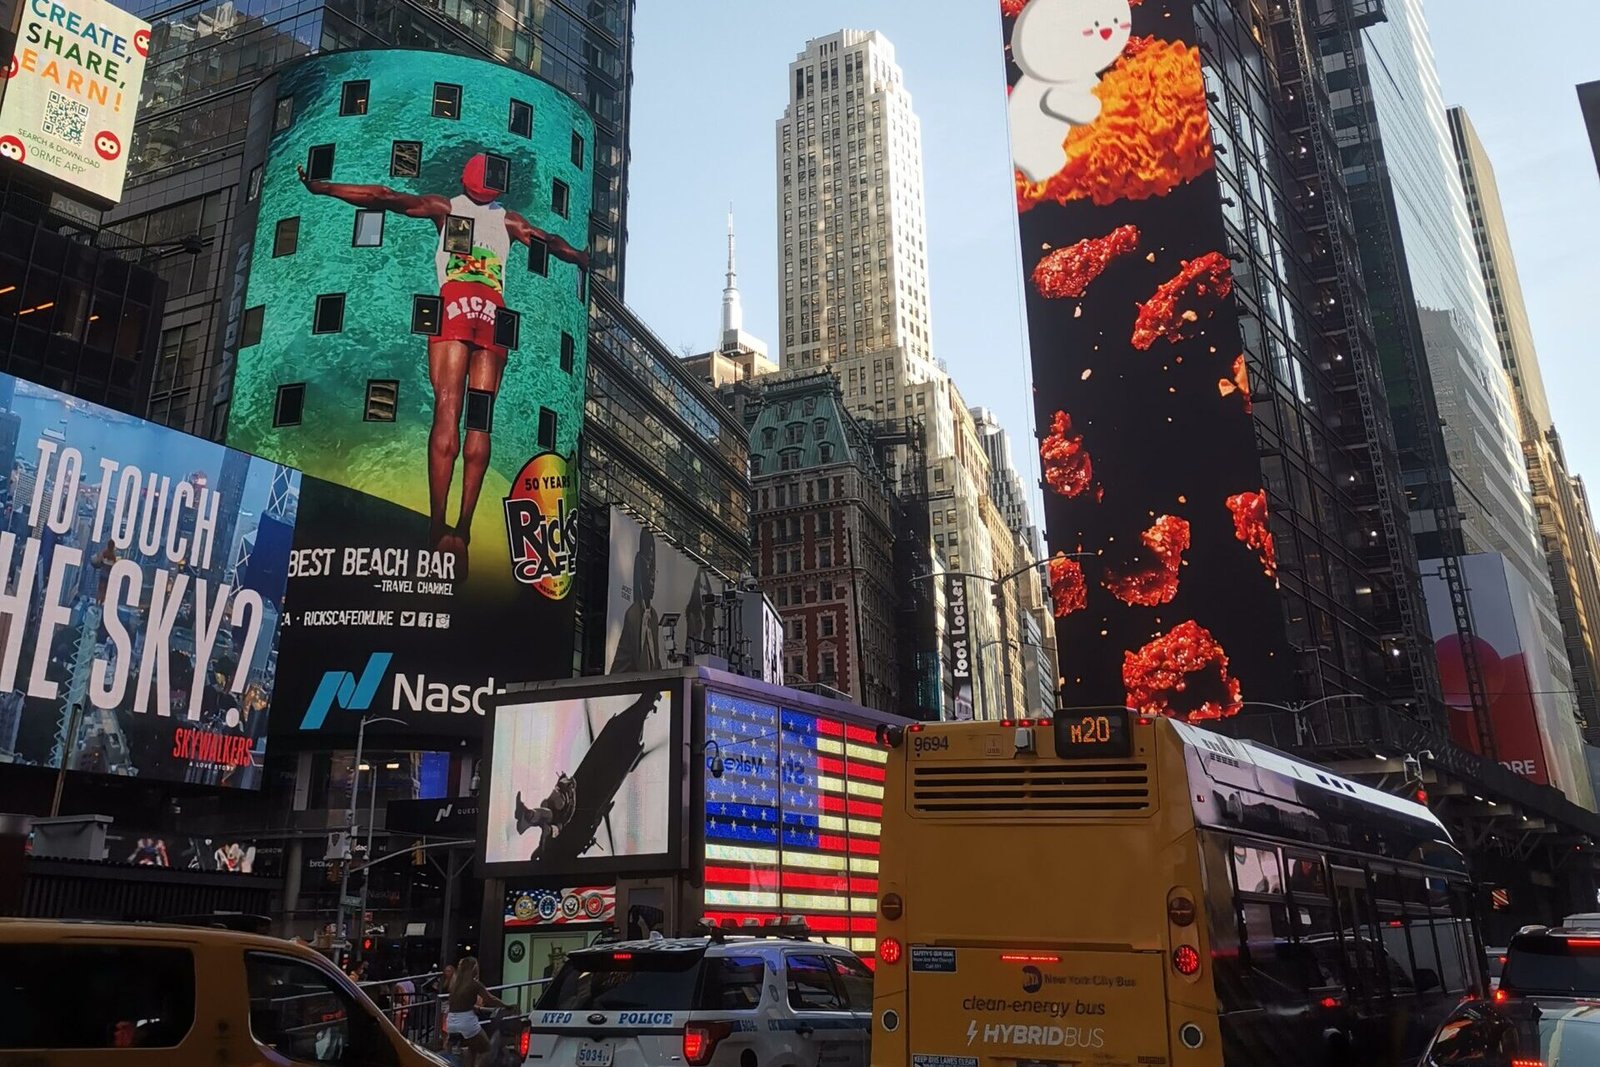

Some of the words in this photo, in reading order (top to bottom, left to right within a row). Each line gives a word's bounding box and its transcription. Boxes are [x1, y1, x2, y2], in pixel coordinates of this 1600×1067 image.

[31, 0, 132, 64] CREATE,
[26, 22, 126, 89] SHARE,
[20, 48, 122, 112] EARN!
[18, 128, 48, 147] SEARCH
[56, 145, 101, 169] DOWNLOAD
[28, 438, 83, 534] TO
[524, 477, 540, 491] 50
[543, 475, 571, 490] YEARS
[92, 457, 221, 570] TOUCH
[287, 549, 335, 578] BEST
[342, 547, 410, 578] BEACH
[416, 550, 456, 580] BAR
[417, 580, 454, 596] CHANNEL
[950, 579, 966, 636] Locker
[303, 610, 395, 626] RICKSCAFEONLINE
[89, 559, 264, 728] SKY?
[953, 639, 969, 678] Foot
[391, 673, 506, 716] Nasd
[173, 728, 254, 768] SKYWALKERS
[913, 735, 949, 752] 9694
[1070, 716, 1111, 744] M20
[1044, 974, 1066, 985] New
[1068, 975, 1092, 985] York
[1092, 975, 1114, 988] City
[1116, 975, 1137, 987] Bus
[541, 1012, 573, 1024] NYPD
[618, 1012, 673, 1025] POLICE
[963, 994, 1070, 1018] clean-energy
[1075, 996, 1106, 1016] bus
